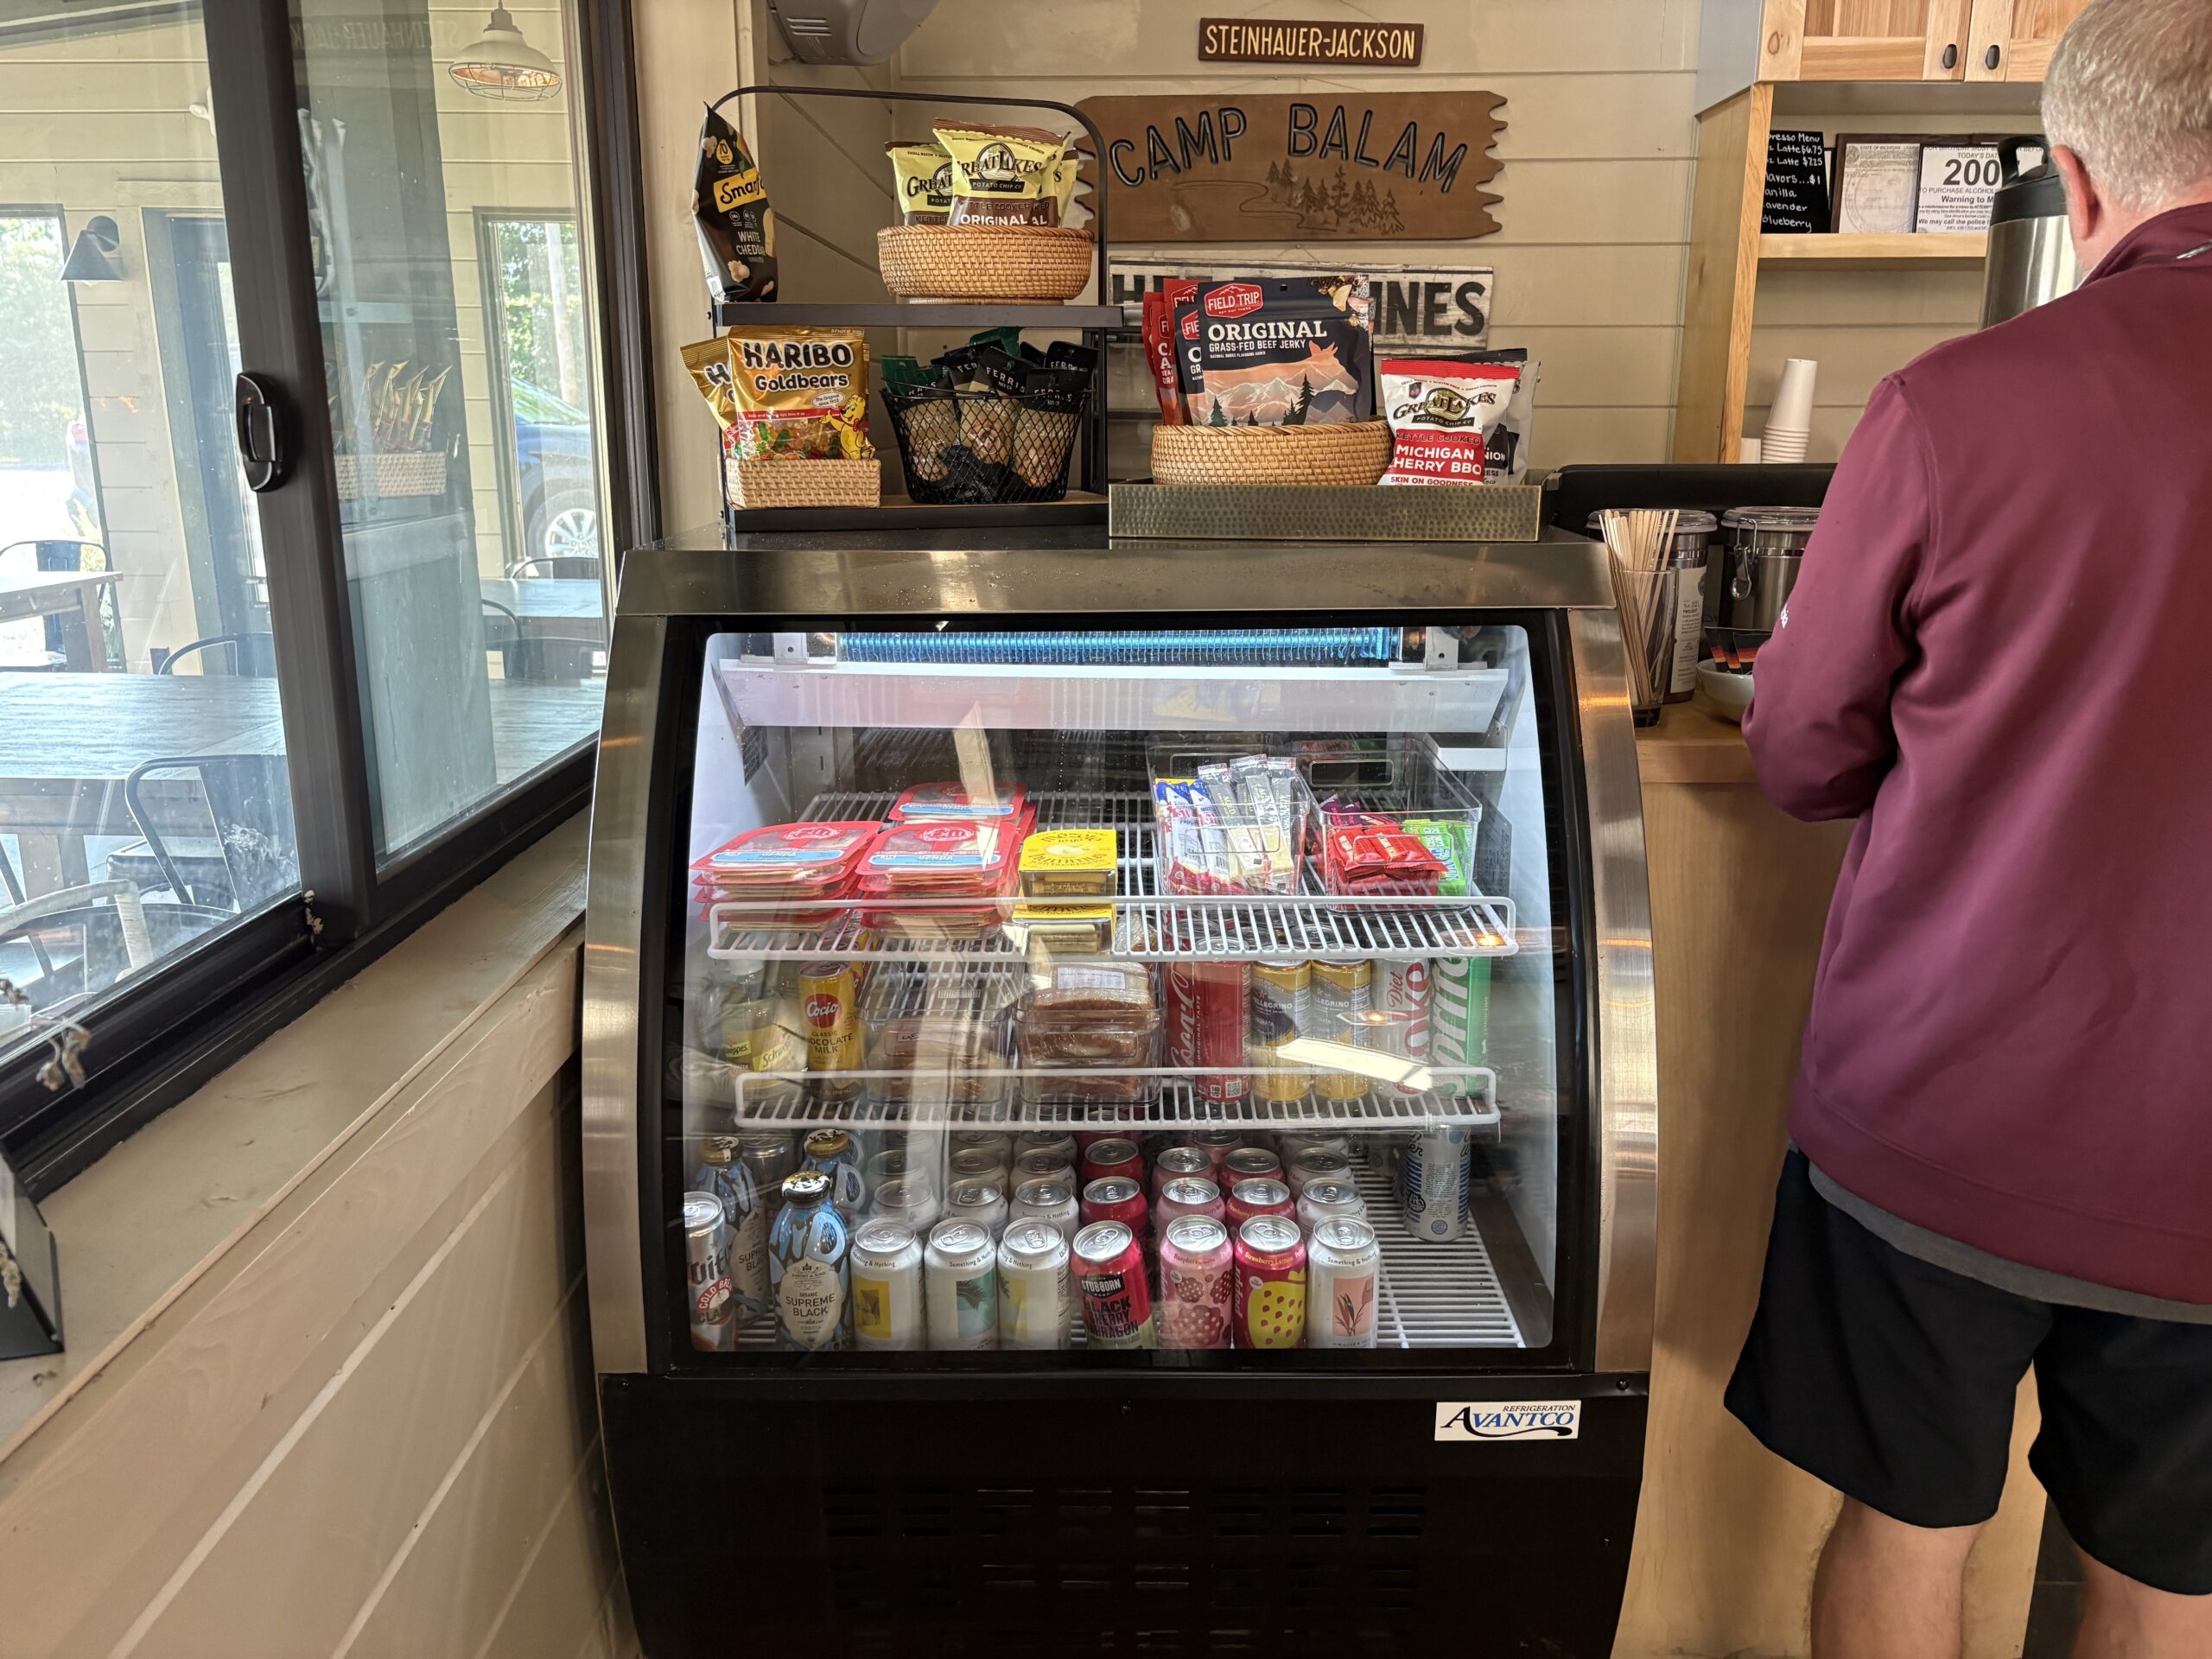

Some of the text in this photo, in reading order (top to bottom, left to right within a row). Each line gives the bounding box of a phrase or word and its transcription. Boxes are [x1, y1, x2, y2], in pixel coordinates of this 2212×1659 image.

[1205, 25, 1416, 60] STEINHAUER-JACKSON
[1798, 132, 1820, 143] Menu
[1109, 103, 1468, 194] CAMP BALAM
[1777, 143, 1801, 153] Latte
[1777, 157, 1799, 166] Latte
[1942, 158, 2000, 186] 200
[1764, 188, 1797, 197] anilla
[1942, 195, 1974, 204] Warning
[993, 202, 1031, 211] COOKED
[1765, 202, 1808, 212] avender
[960, 213, 1028, 226] ORIGINAL
[737, 231, 761, 243] WHITE
[1208, 296, 1236, 311] FIELD
[1236, 292, 1260, 307] TRIP
[1370, 282, 1486, 337] INES
[1208, 321, 1327, 341] ORIGINAL
[1209, 340, 1306, 353] GRASS-FED BEEF JERKY
[743, 342, 853, 369] HARIBO
[755, 373, 849, 391] Goldbears
[986, 366, 1026, 394] FERRIS
[824, 393, 840, 402] Original
[1416, 416, 1444, 424] POTATO
[1396, 433, 1481, 446] KETTLE COOKED
[1395, 444, 1475, 461] MICHIGAN
[1451, 461, 1482, 475] BBQ
[1386, 970, 1403, 1008] Diet
[806, 1000, 841, 1019] Cocio
[950, 1259, 976, 1268] Something
[1014, 1258, 1033, 1269] Nothing
[1244, 1251, 1294, 1267] Strawberry Lemon
[1327, 1255, 1355, 1267] Something
[1081, 1278, 1122, 1293] STUBBORN
[698, 1286, 716, 1309] COLD
[785, 1293, 836, 1307] SUPREME
[793, 1306, 829, 1318] BLACK
[1503, 1404, 1575, 1413] REFRIGERATION
[1440, 1406, 1575, 1438] AVANTCO
